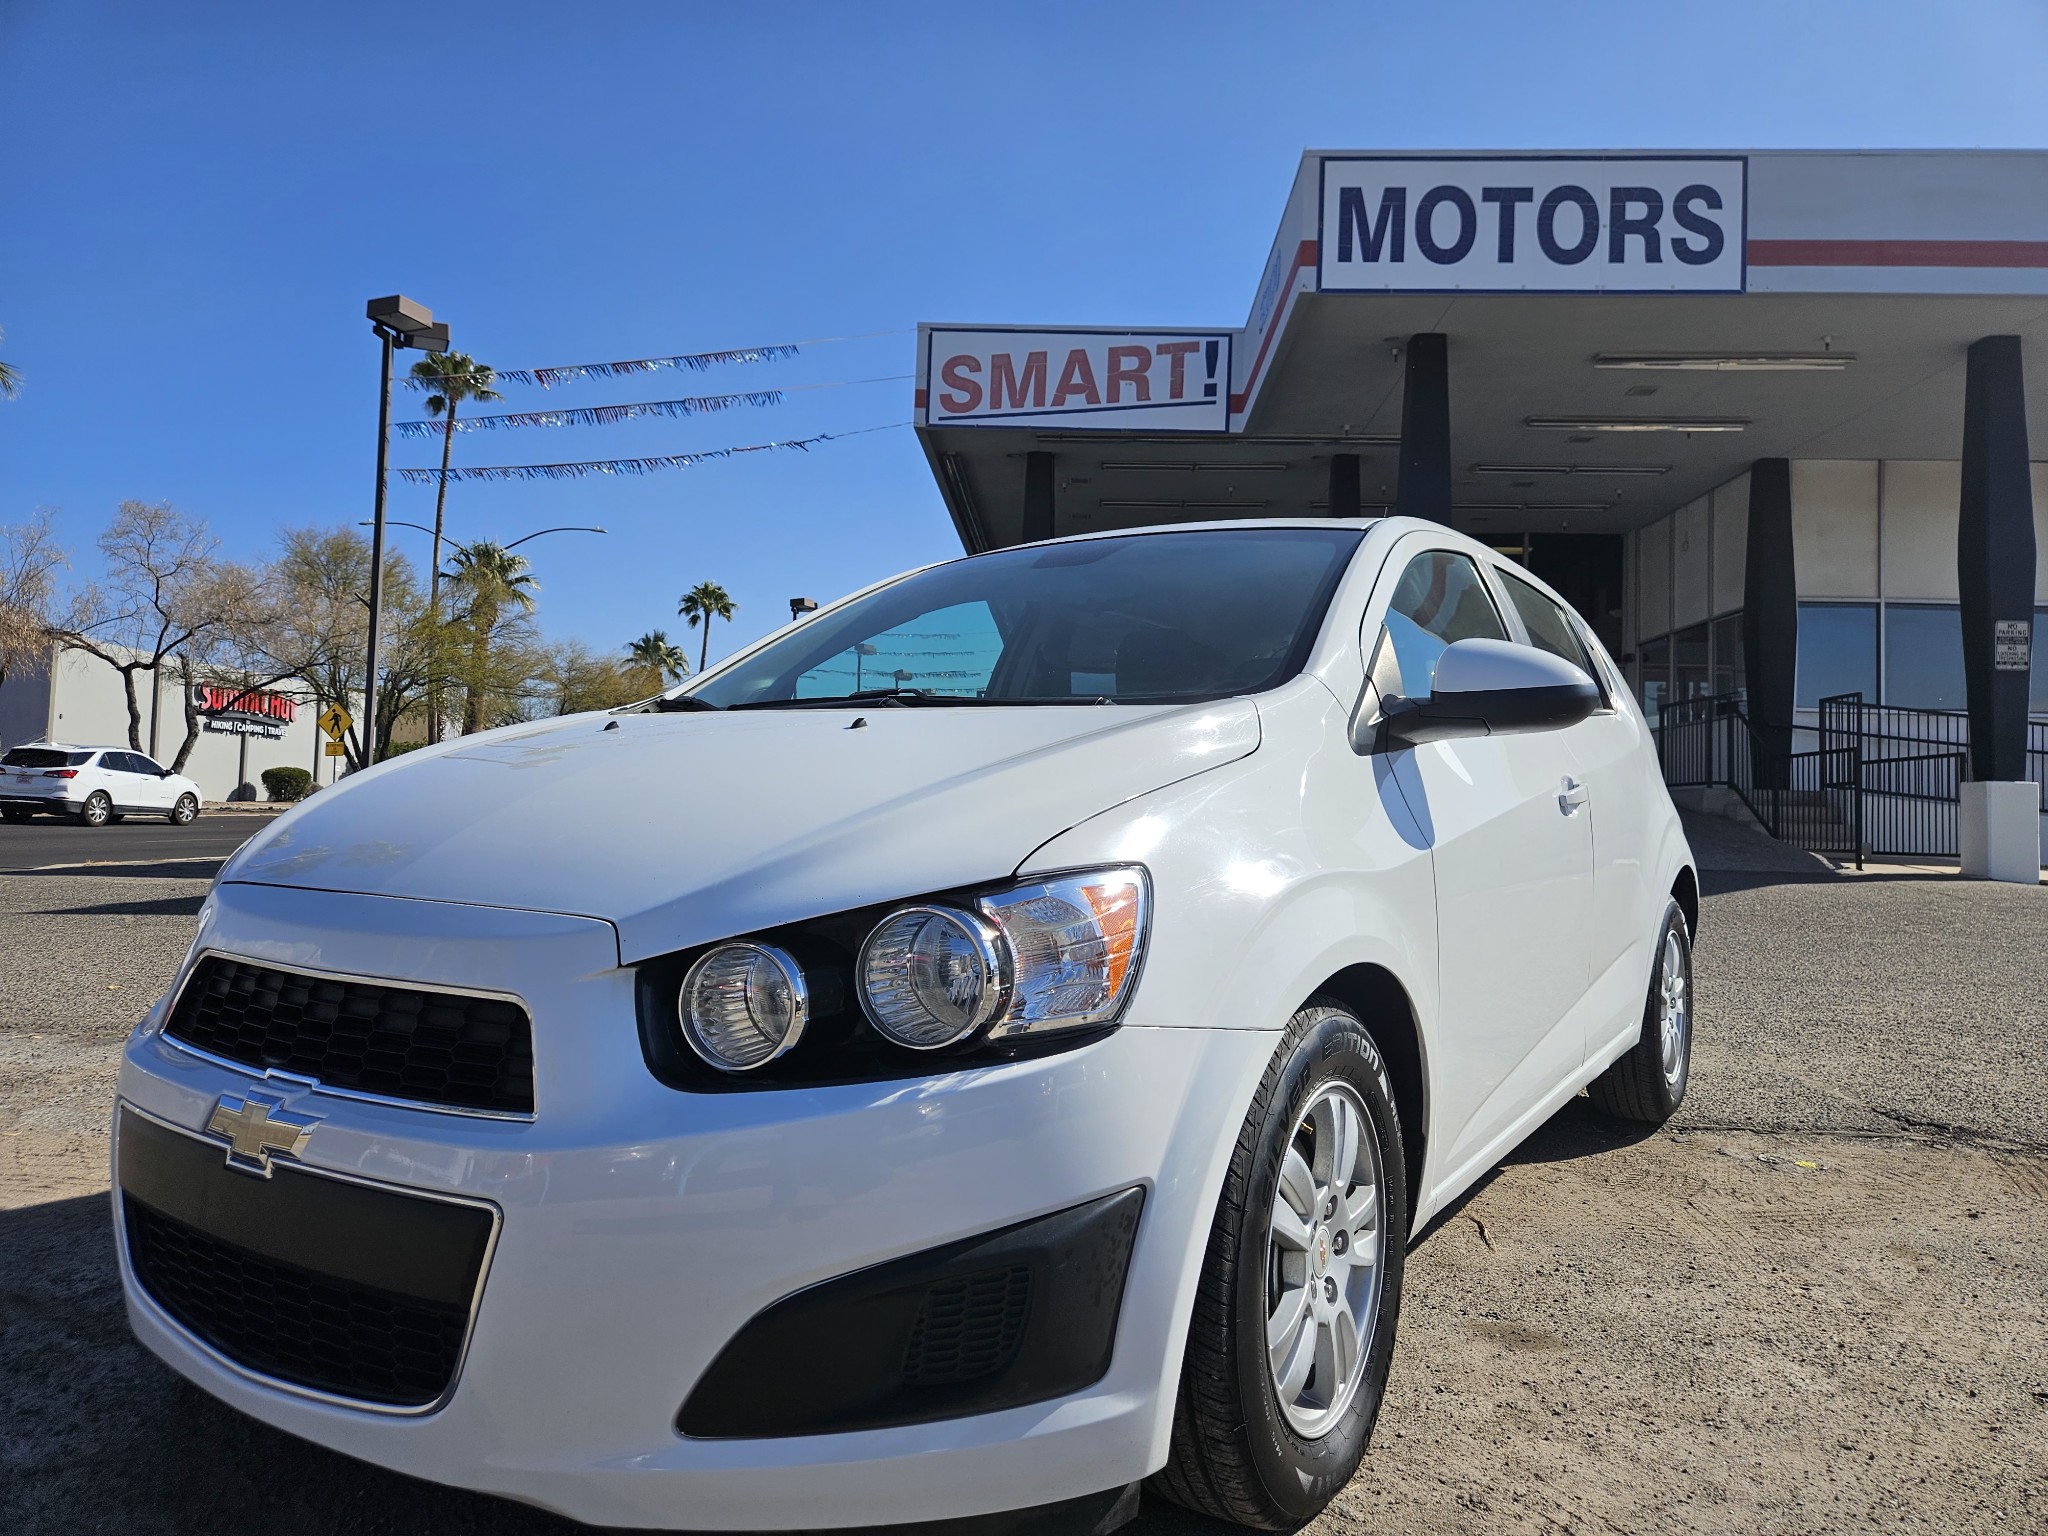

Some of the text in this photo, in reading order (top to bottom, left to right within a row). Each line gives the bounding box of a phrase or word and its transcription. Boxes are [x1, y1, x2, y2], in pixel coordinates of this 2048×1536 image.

[1336, 183, 1725, 267] MOTORS
[939, 340, 1219, 415] SMART!
[210, 720, 289, 737] HIKING CAMPING TRAVEL
[1322, 1031, 1380, 1077] EDITION
